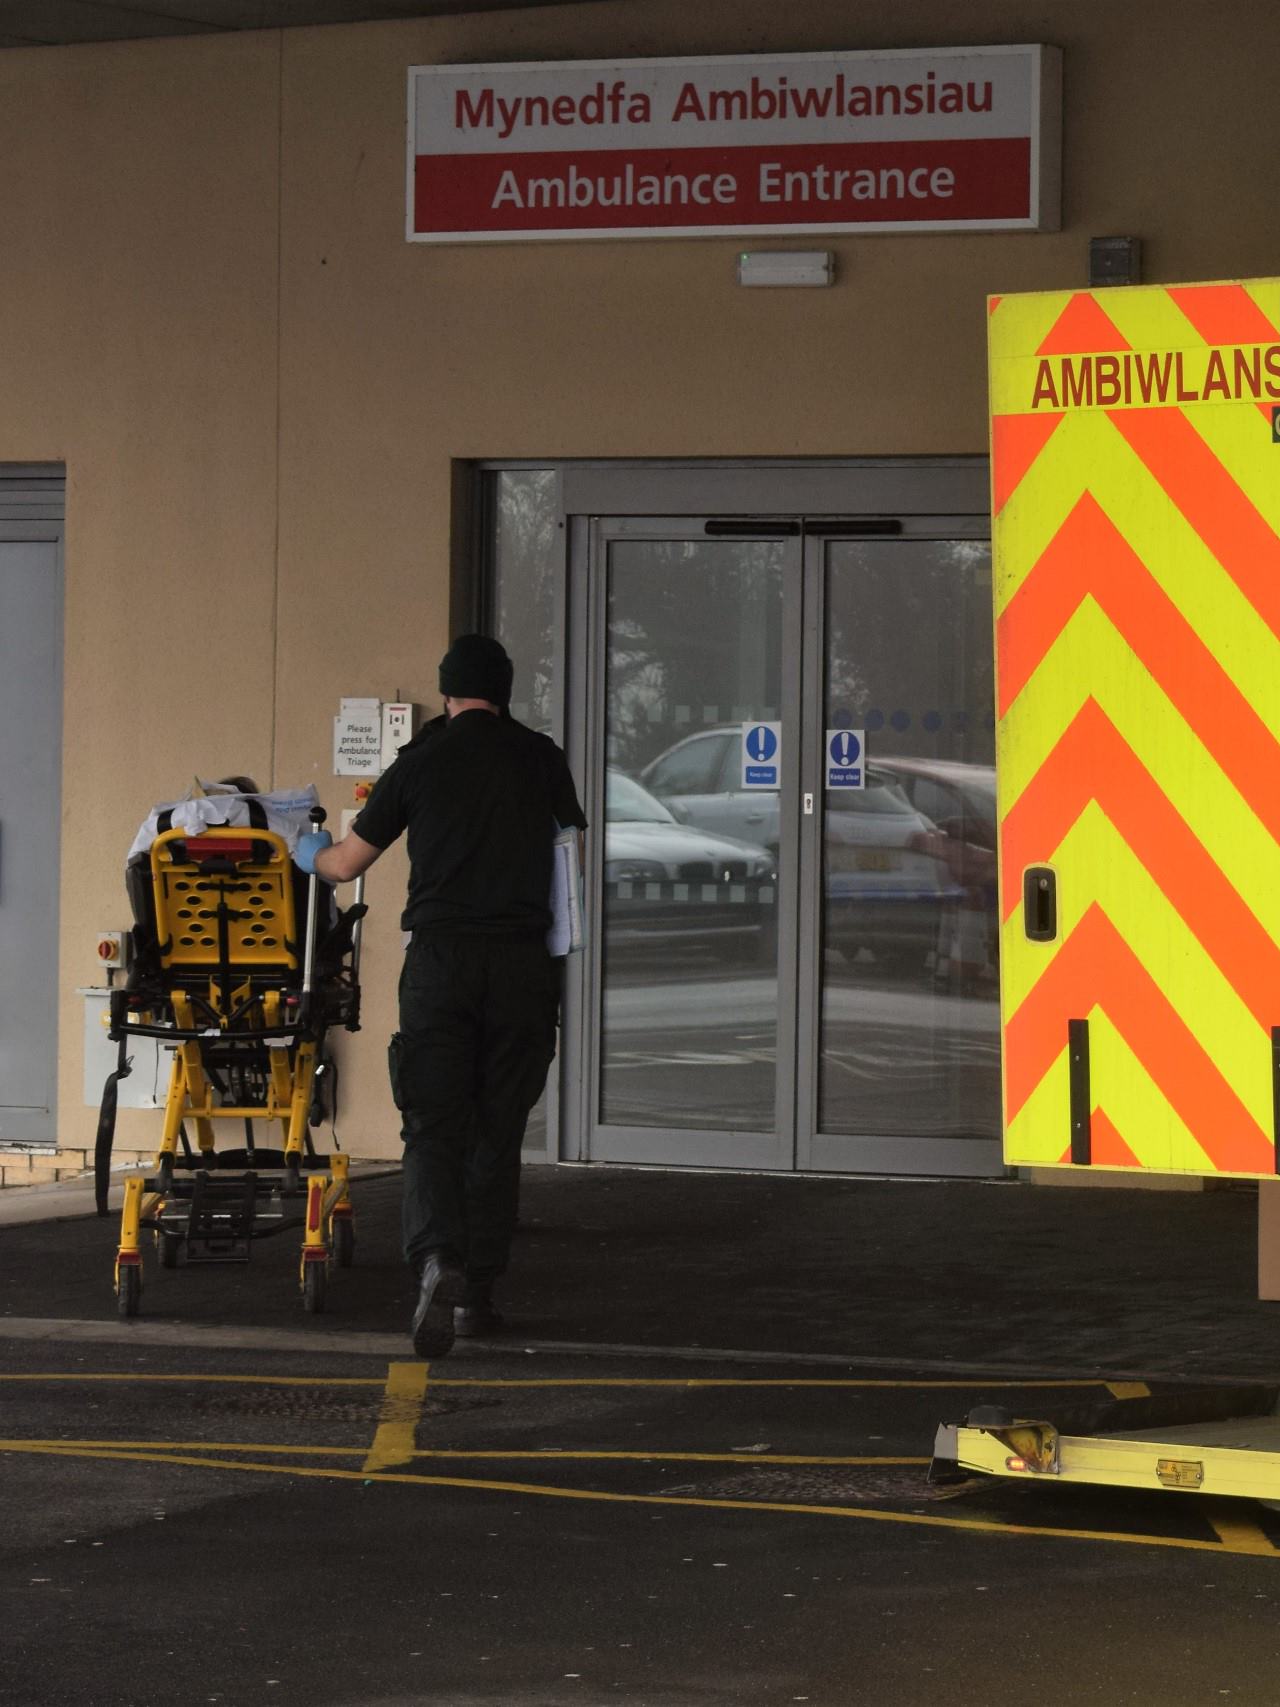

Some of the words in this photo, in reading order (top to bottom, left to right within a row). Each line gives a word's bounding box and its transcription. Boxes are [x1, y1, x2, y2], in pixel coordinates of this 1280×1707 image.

[455, 82, 651, 138] Mynedfa
[672, 72, 993, 123] Ambiwlansiau
[492, 164, 737, 209] Ambulance
[759, 162, 955, 202] Entrance
[347, 724, 372, 733] Please
[341, 737, 362, 745] press
[366, 735, 377, 744] for
[337, 746, 381, 755] Ambulance
[347, 757, 372, 767] Triage
[830, 772, 845, 781] Keep
[846, 772, 860, 780] clear
